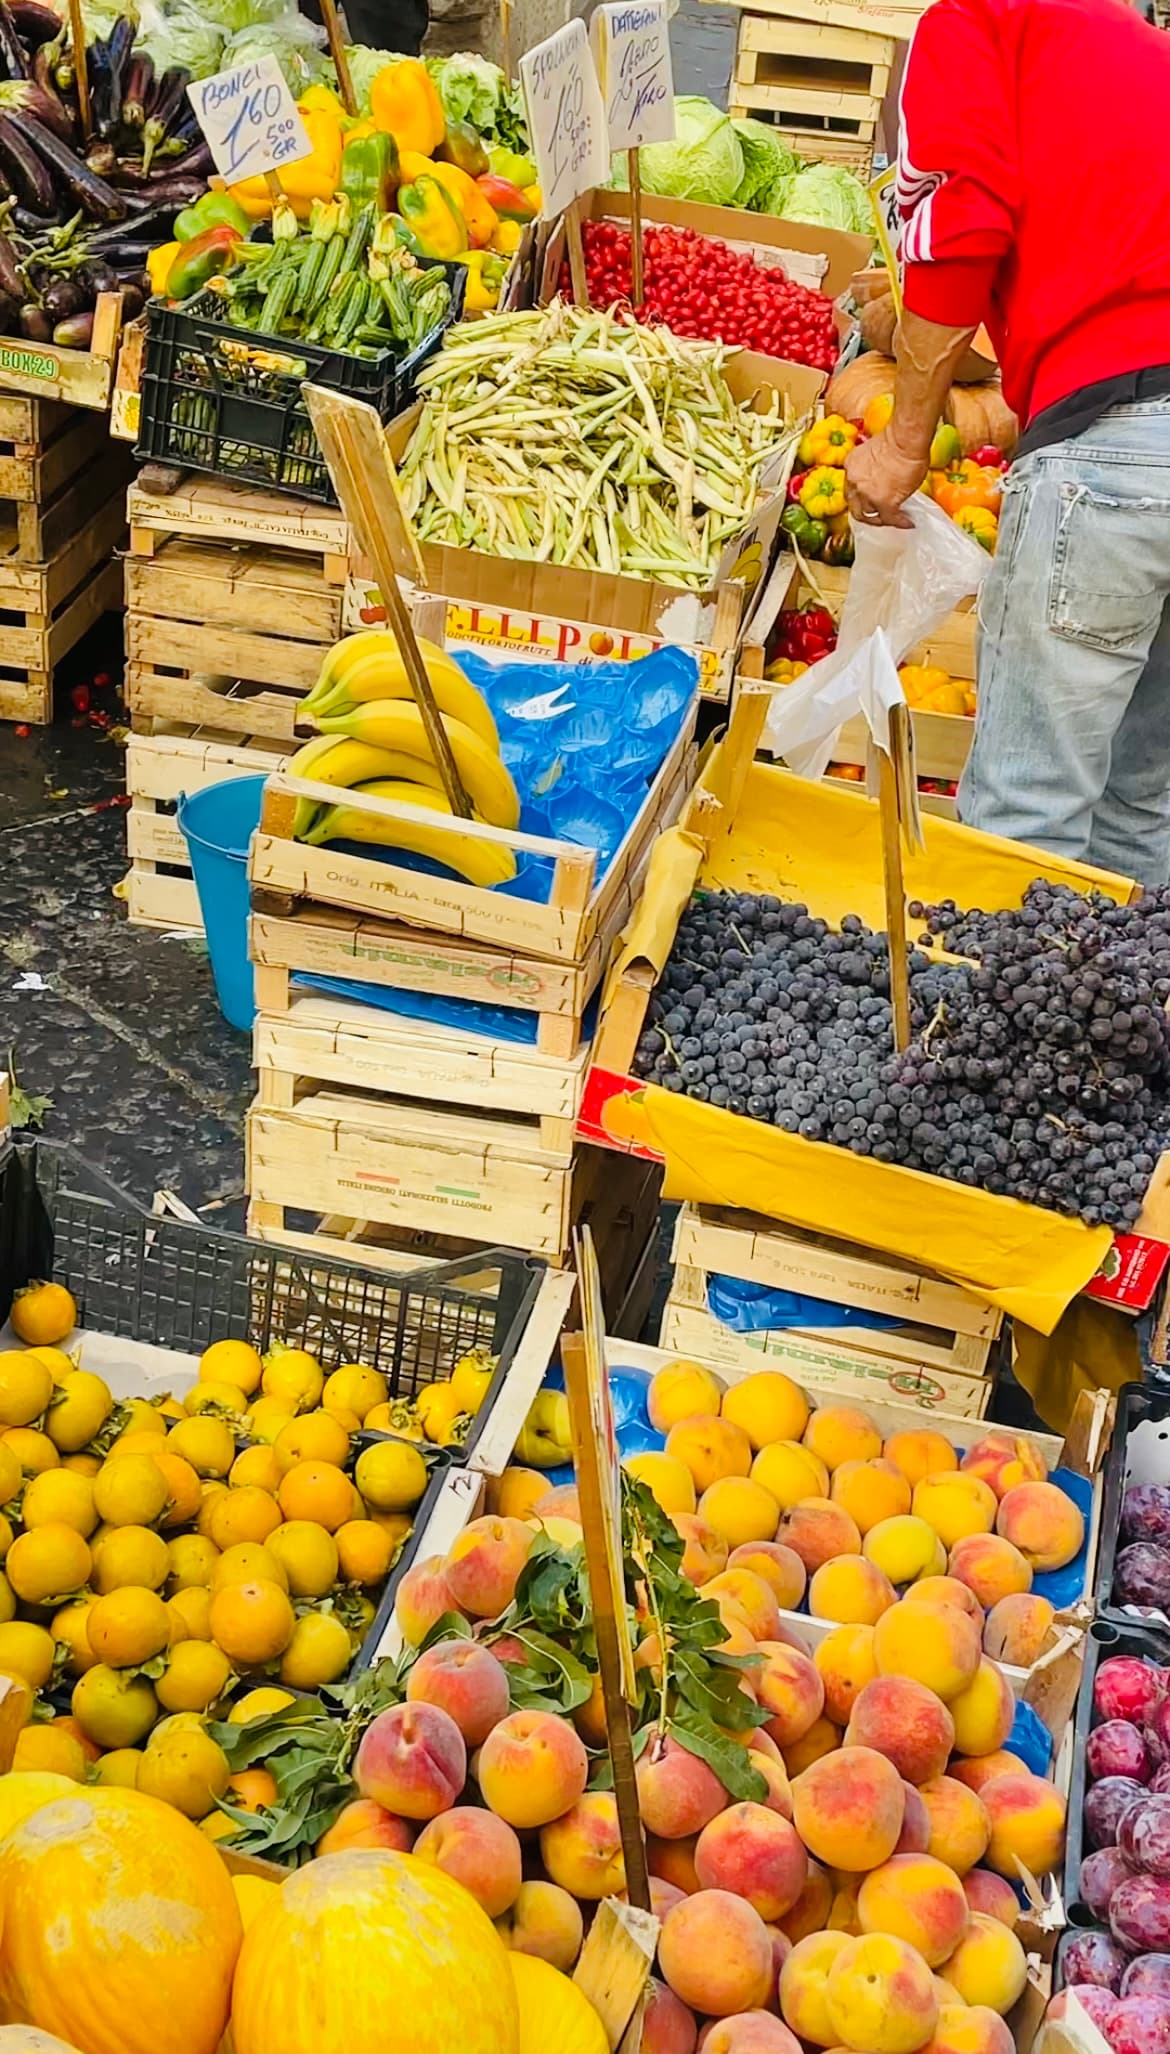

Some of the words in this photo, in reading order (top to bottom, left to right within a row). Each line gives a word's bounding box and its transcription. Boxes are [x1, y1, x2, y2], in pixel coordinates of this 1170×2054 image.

[266, 119, 294, 145] 500
[272, 137, 297, 160] GR
[369, 880, 420, 902] ITALIA
[336, 1178, 363, 1191] ITALIA
[363, 1183, 397, 1196] ORIGINE
[399, 1190, 449, 1205] SELEZIONATI
[451, 1199, 493, 1213] PRODOTTI
